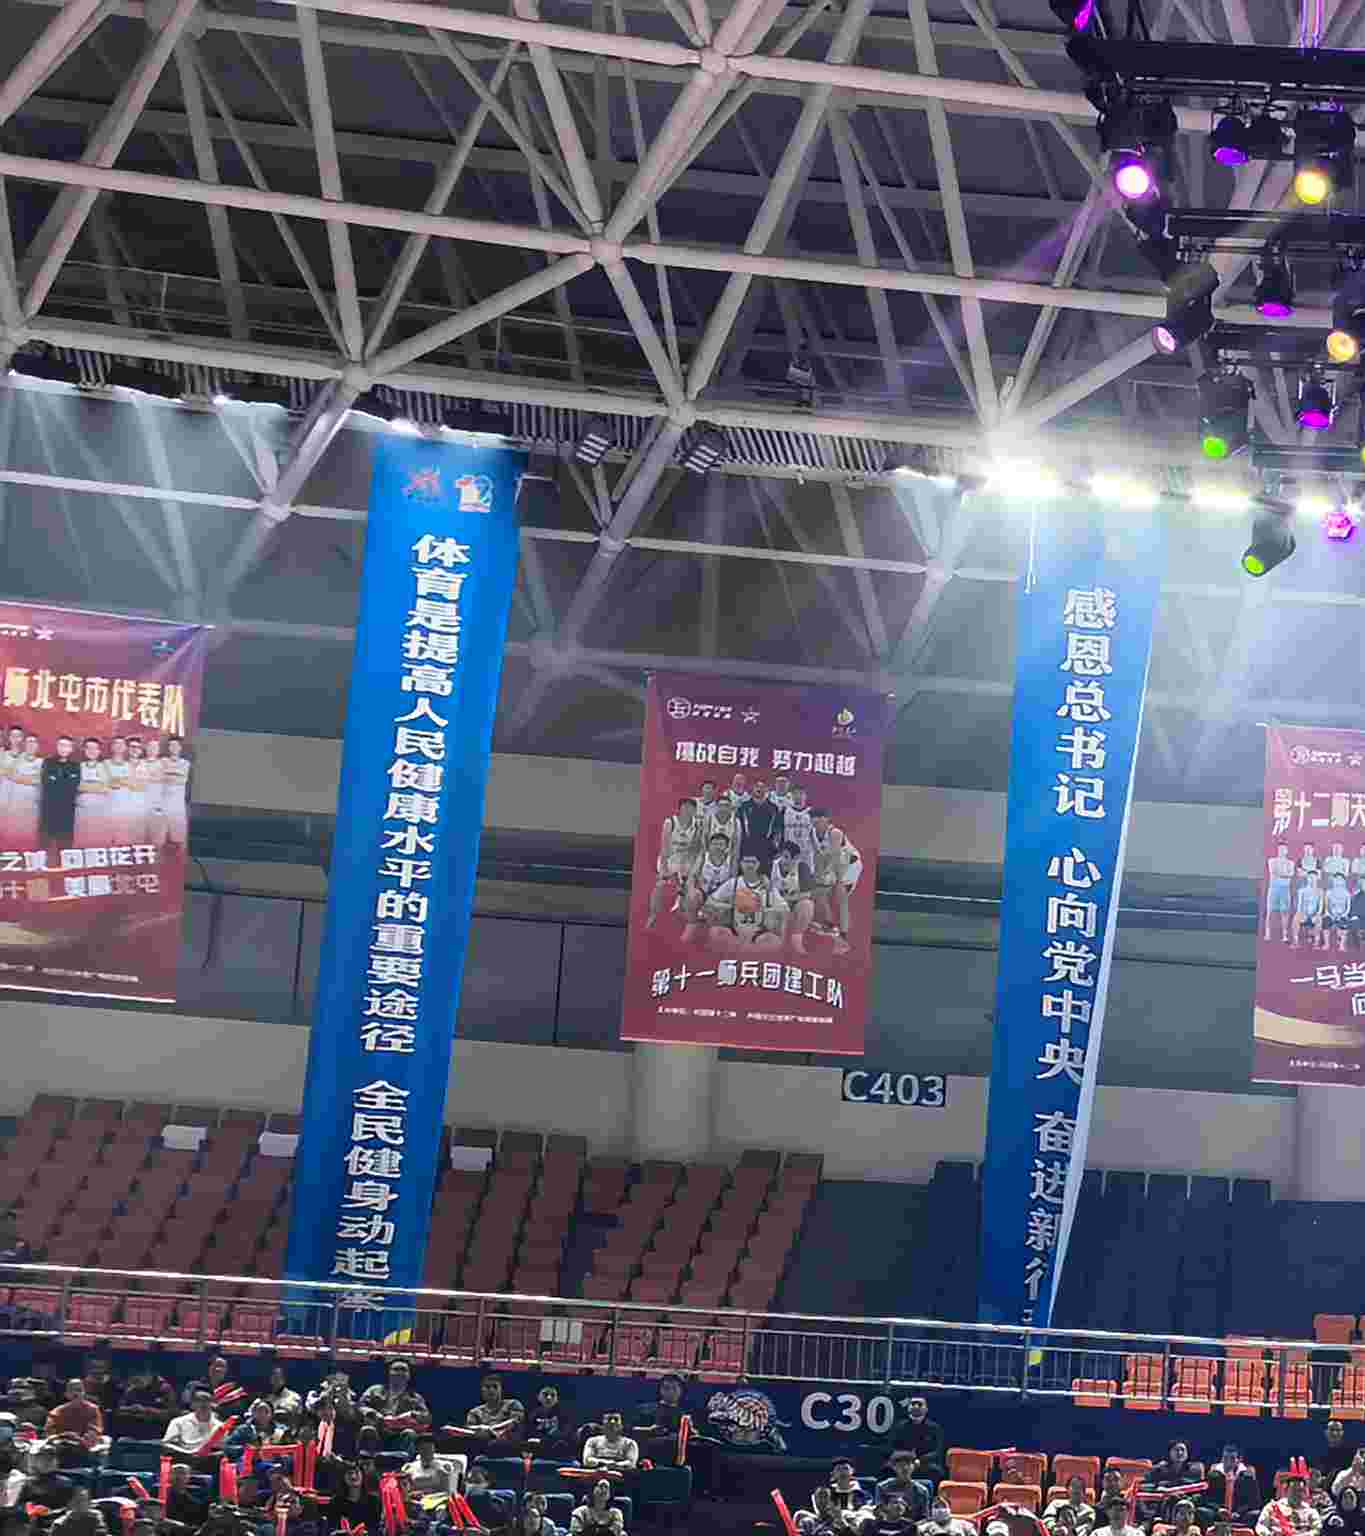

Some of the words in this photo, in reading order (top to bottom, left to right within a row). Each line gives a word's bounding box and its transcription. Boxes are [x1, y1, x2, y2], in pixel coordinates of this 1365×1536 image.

[360, 533, 470, 1053] 体育是提高人民健康水平的重要途径
[1053, 586, 1116, 820] 感恩总书记
[1035, 847, 1102, 1086] 心向党中央
[843, 1071, 944, 1105] C403
[801, 1391, 914, 1433] C30
